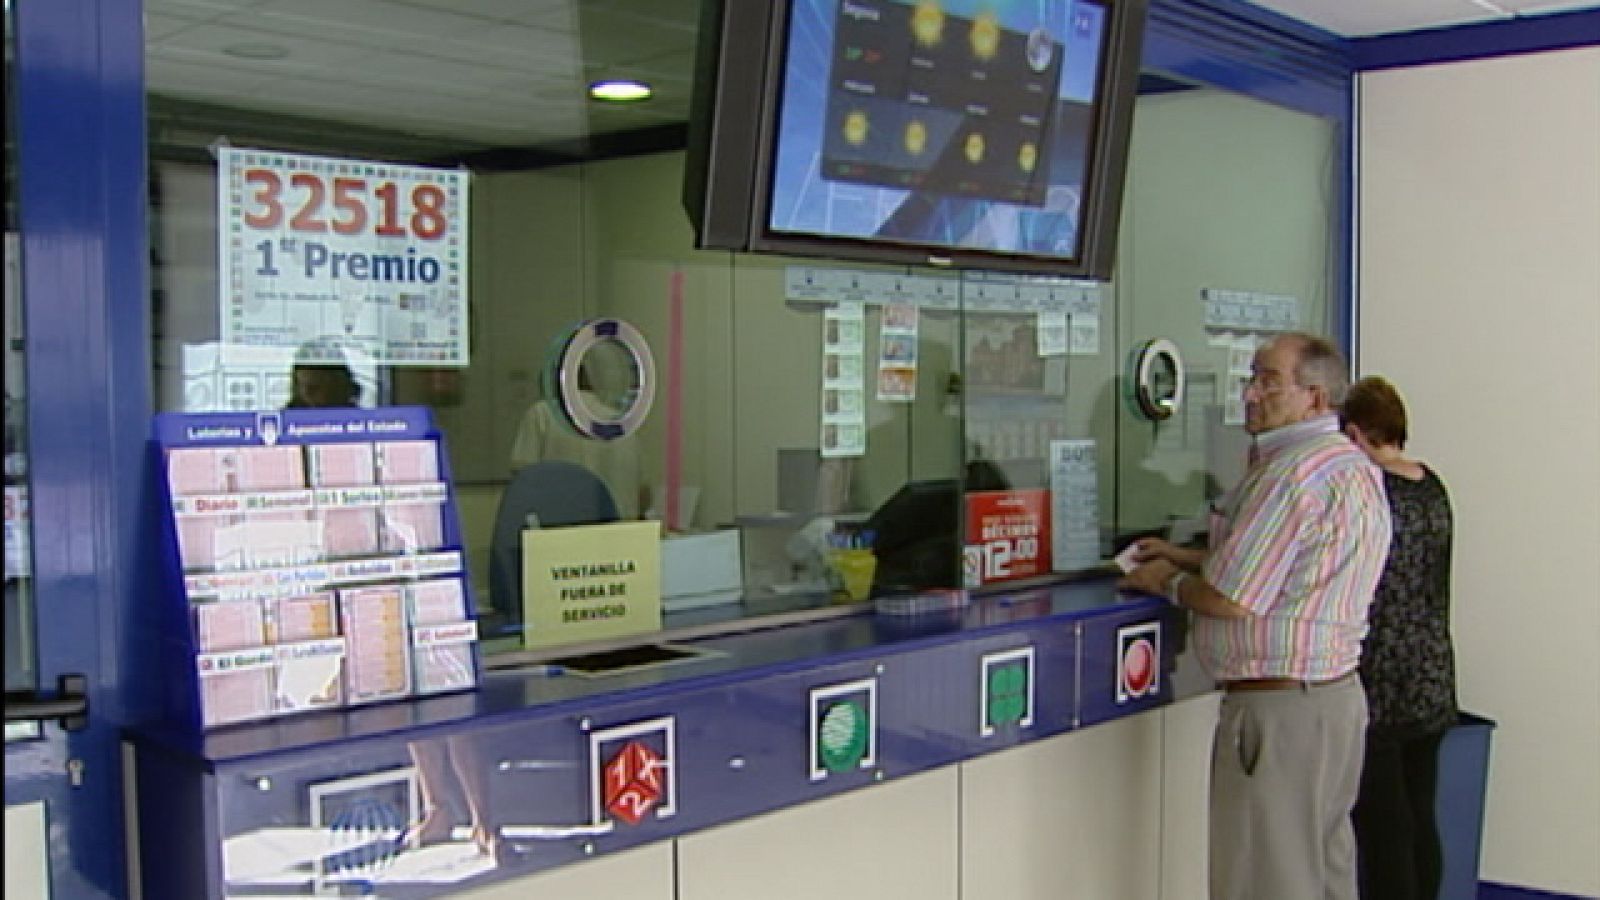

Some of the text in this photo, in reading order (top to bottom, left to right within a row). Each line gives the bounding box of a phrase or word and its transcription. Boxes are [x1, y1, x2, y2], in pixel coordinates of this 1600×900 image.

[244, 168, 447, 240] 32518
[303, 241, 441, 284] Premio
[550, 559, 636, 581] VENTANILLA
[559, 582, 627, 602] FUERA DE
[562, 603, 627, 624] SERVICIO
